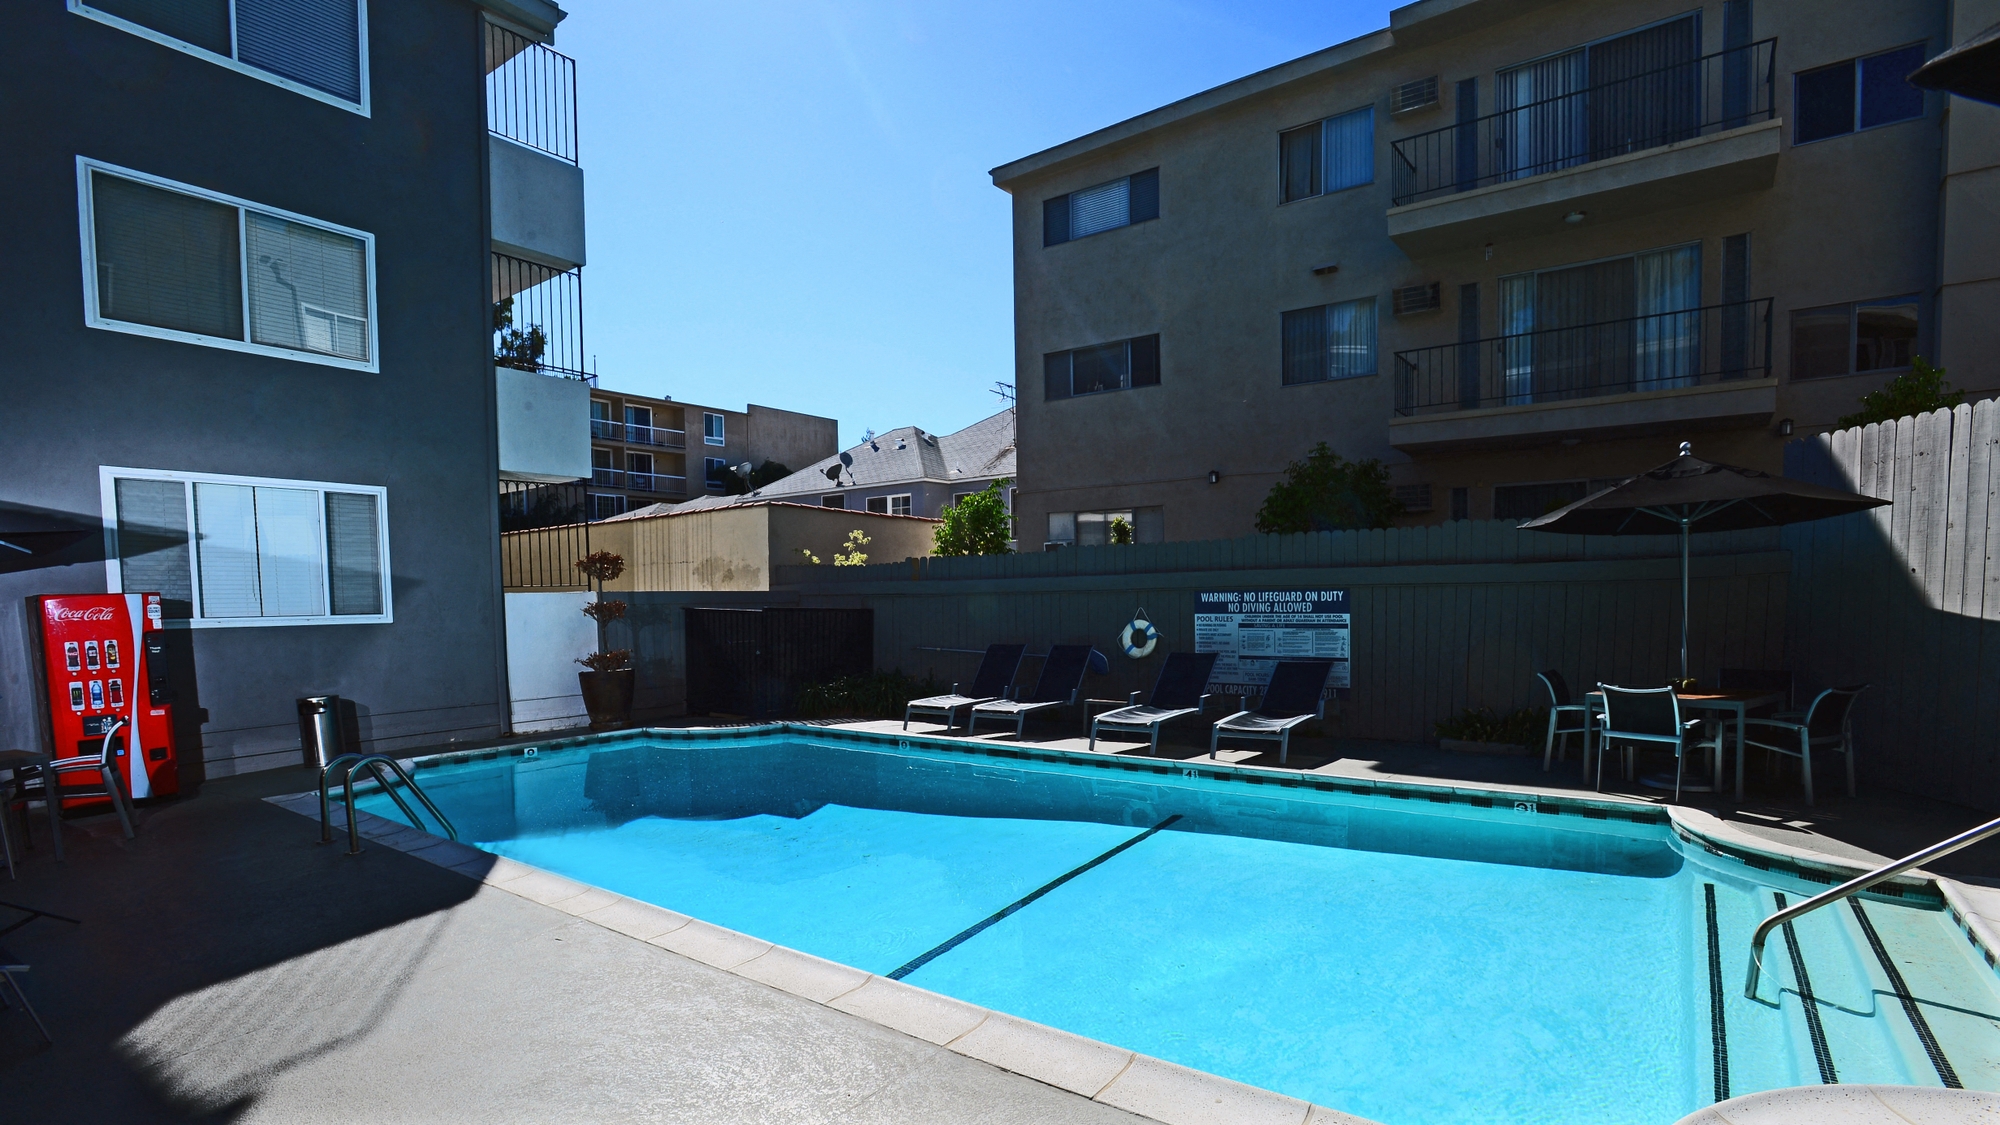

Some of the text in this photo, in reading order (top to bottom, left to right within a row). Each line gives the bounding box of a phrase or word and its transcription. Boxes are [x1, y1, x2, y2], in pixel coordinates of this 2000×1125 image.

[1201, 591, 1344, 602] WARNING: NO LIFEGUARD ON DUTY
[1228, 603, 1312, 613] NO DIVING ALLOWED
[54, 606, 116, 622] Coca-Cola
[1206, 684, 1224, 695] POOL
[1225, 684, 1256, 695] CAPACITY
